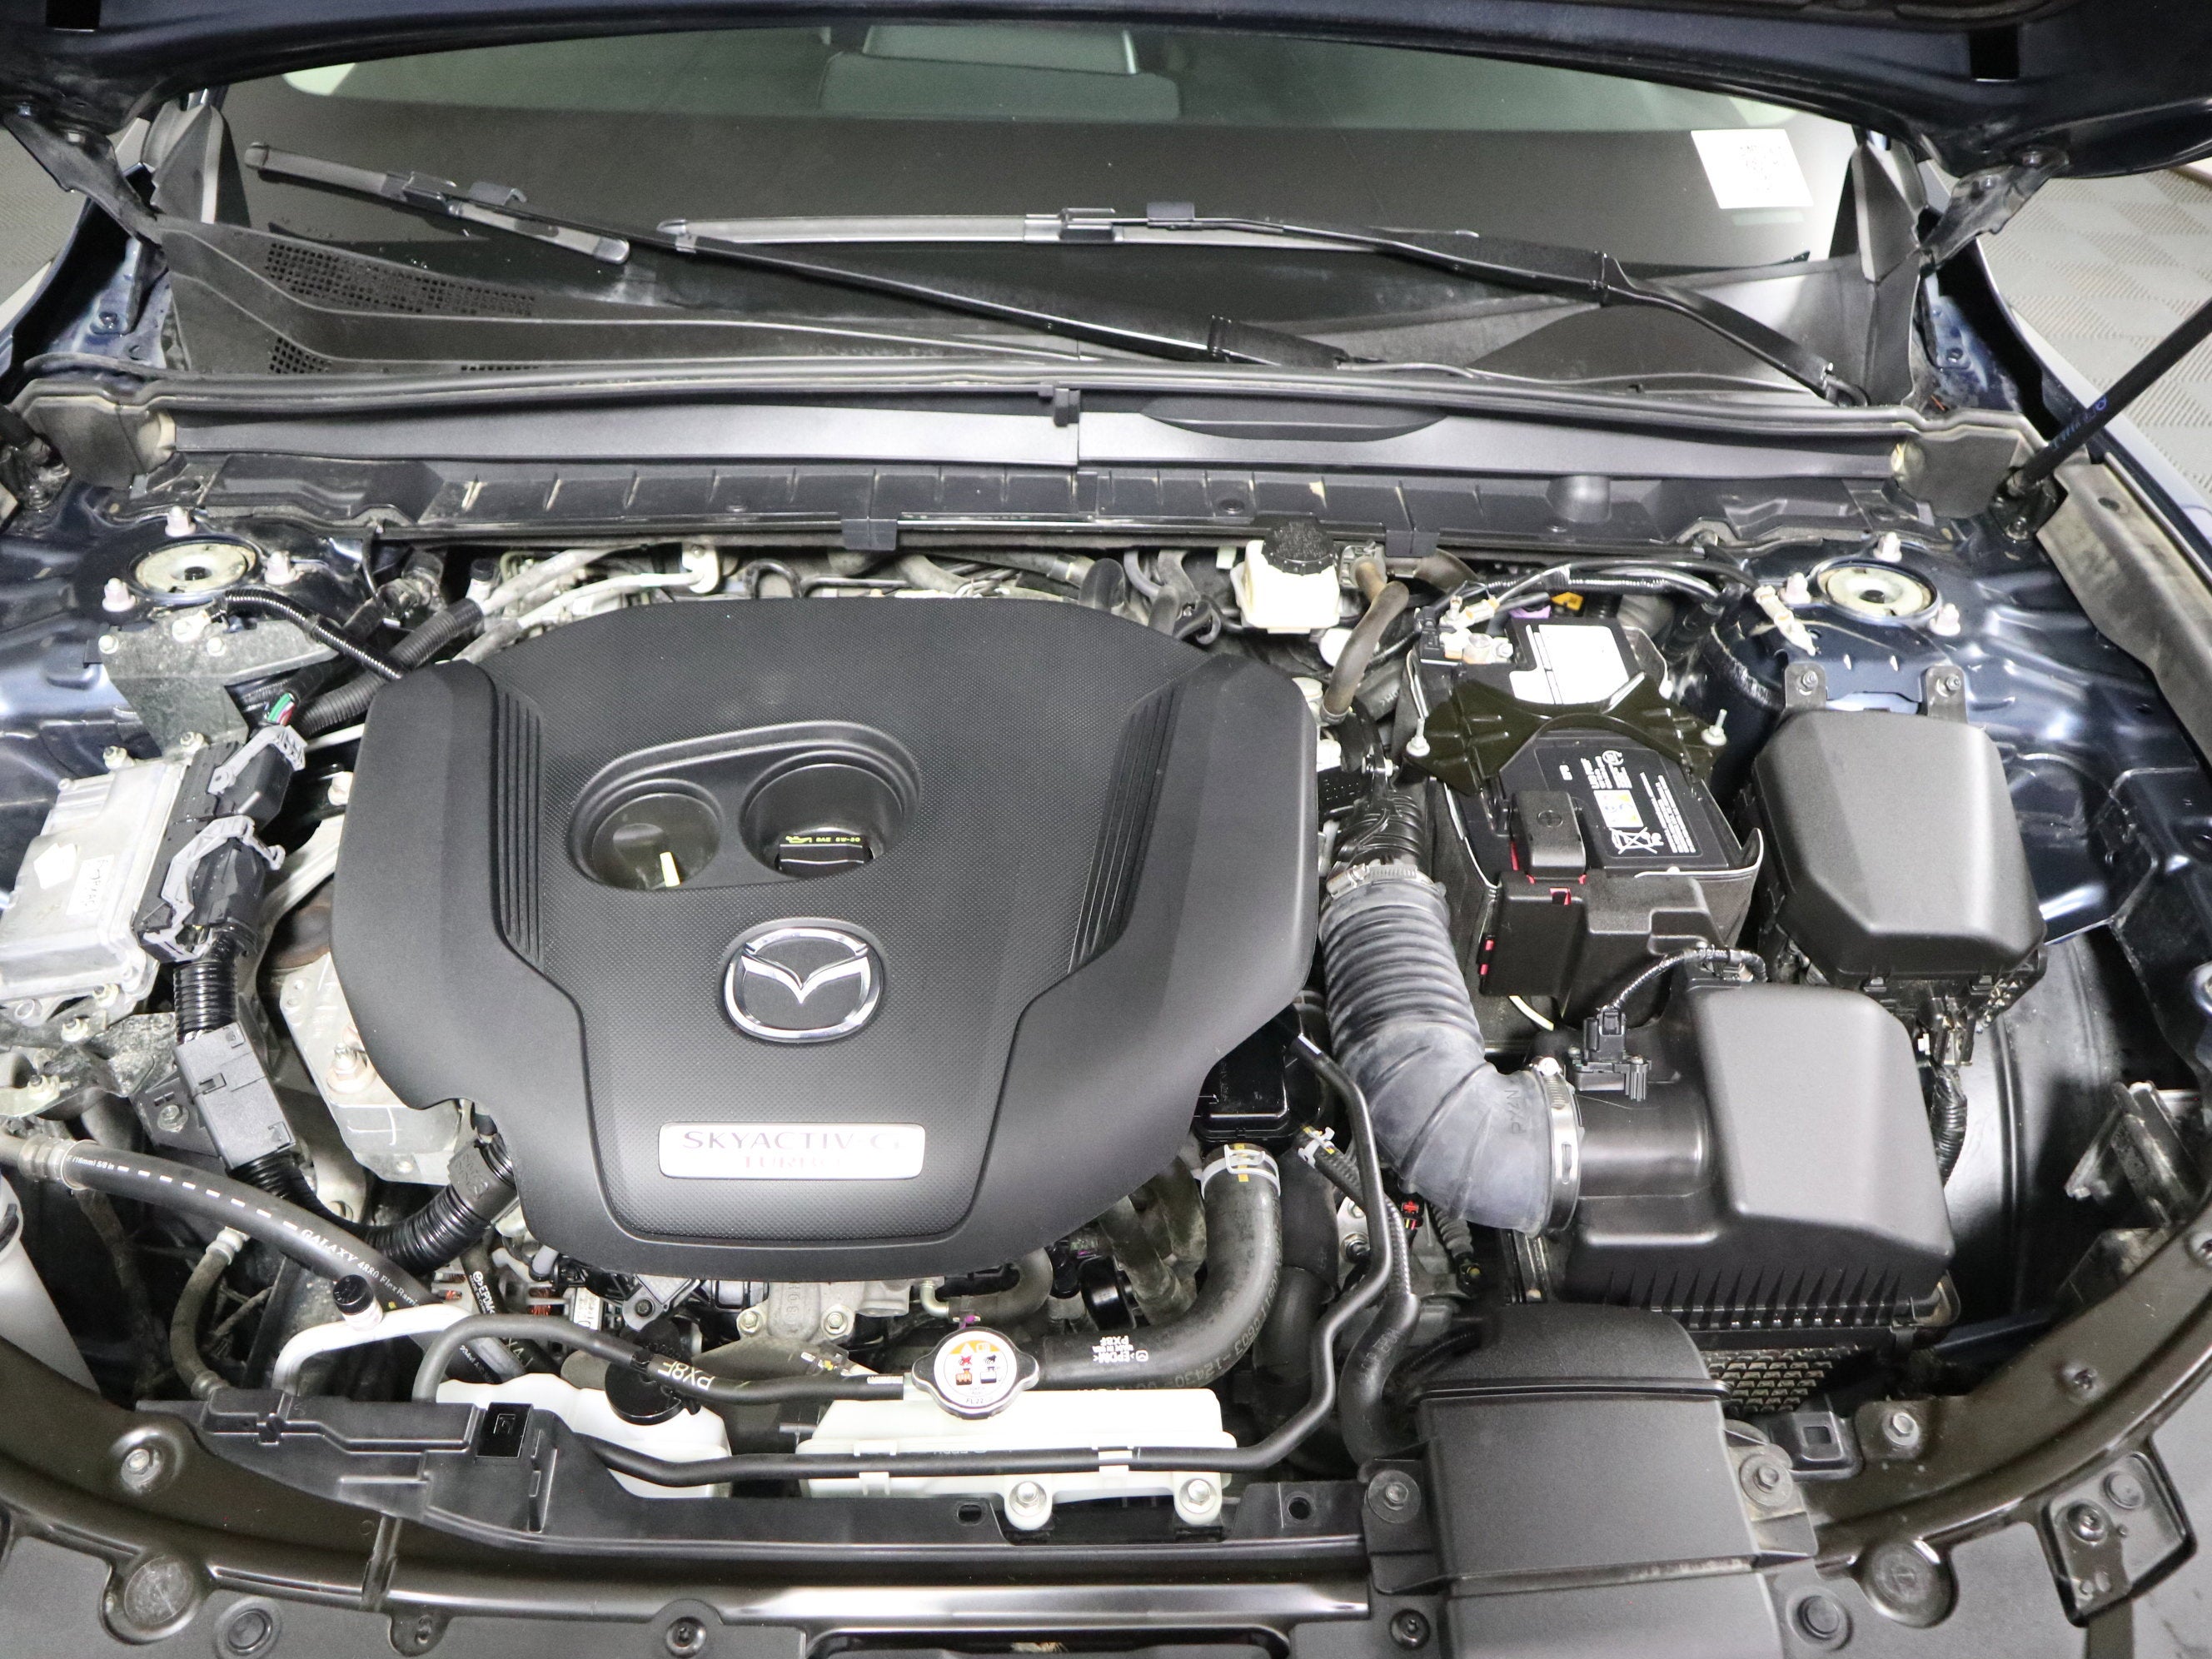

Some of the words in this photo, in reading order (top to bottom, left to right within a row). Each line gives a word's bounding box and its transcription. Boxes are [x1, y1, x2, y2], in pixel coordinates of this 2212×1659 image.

[97, 1160, 108, 1168] 5/8
[301, 1229, 359, 1263] GALAXY
[357, 1261, 380, 1278] 4880
[657, 1360, 716, 1391] PX8F
